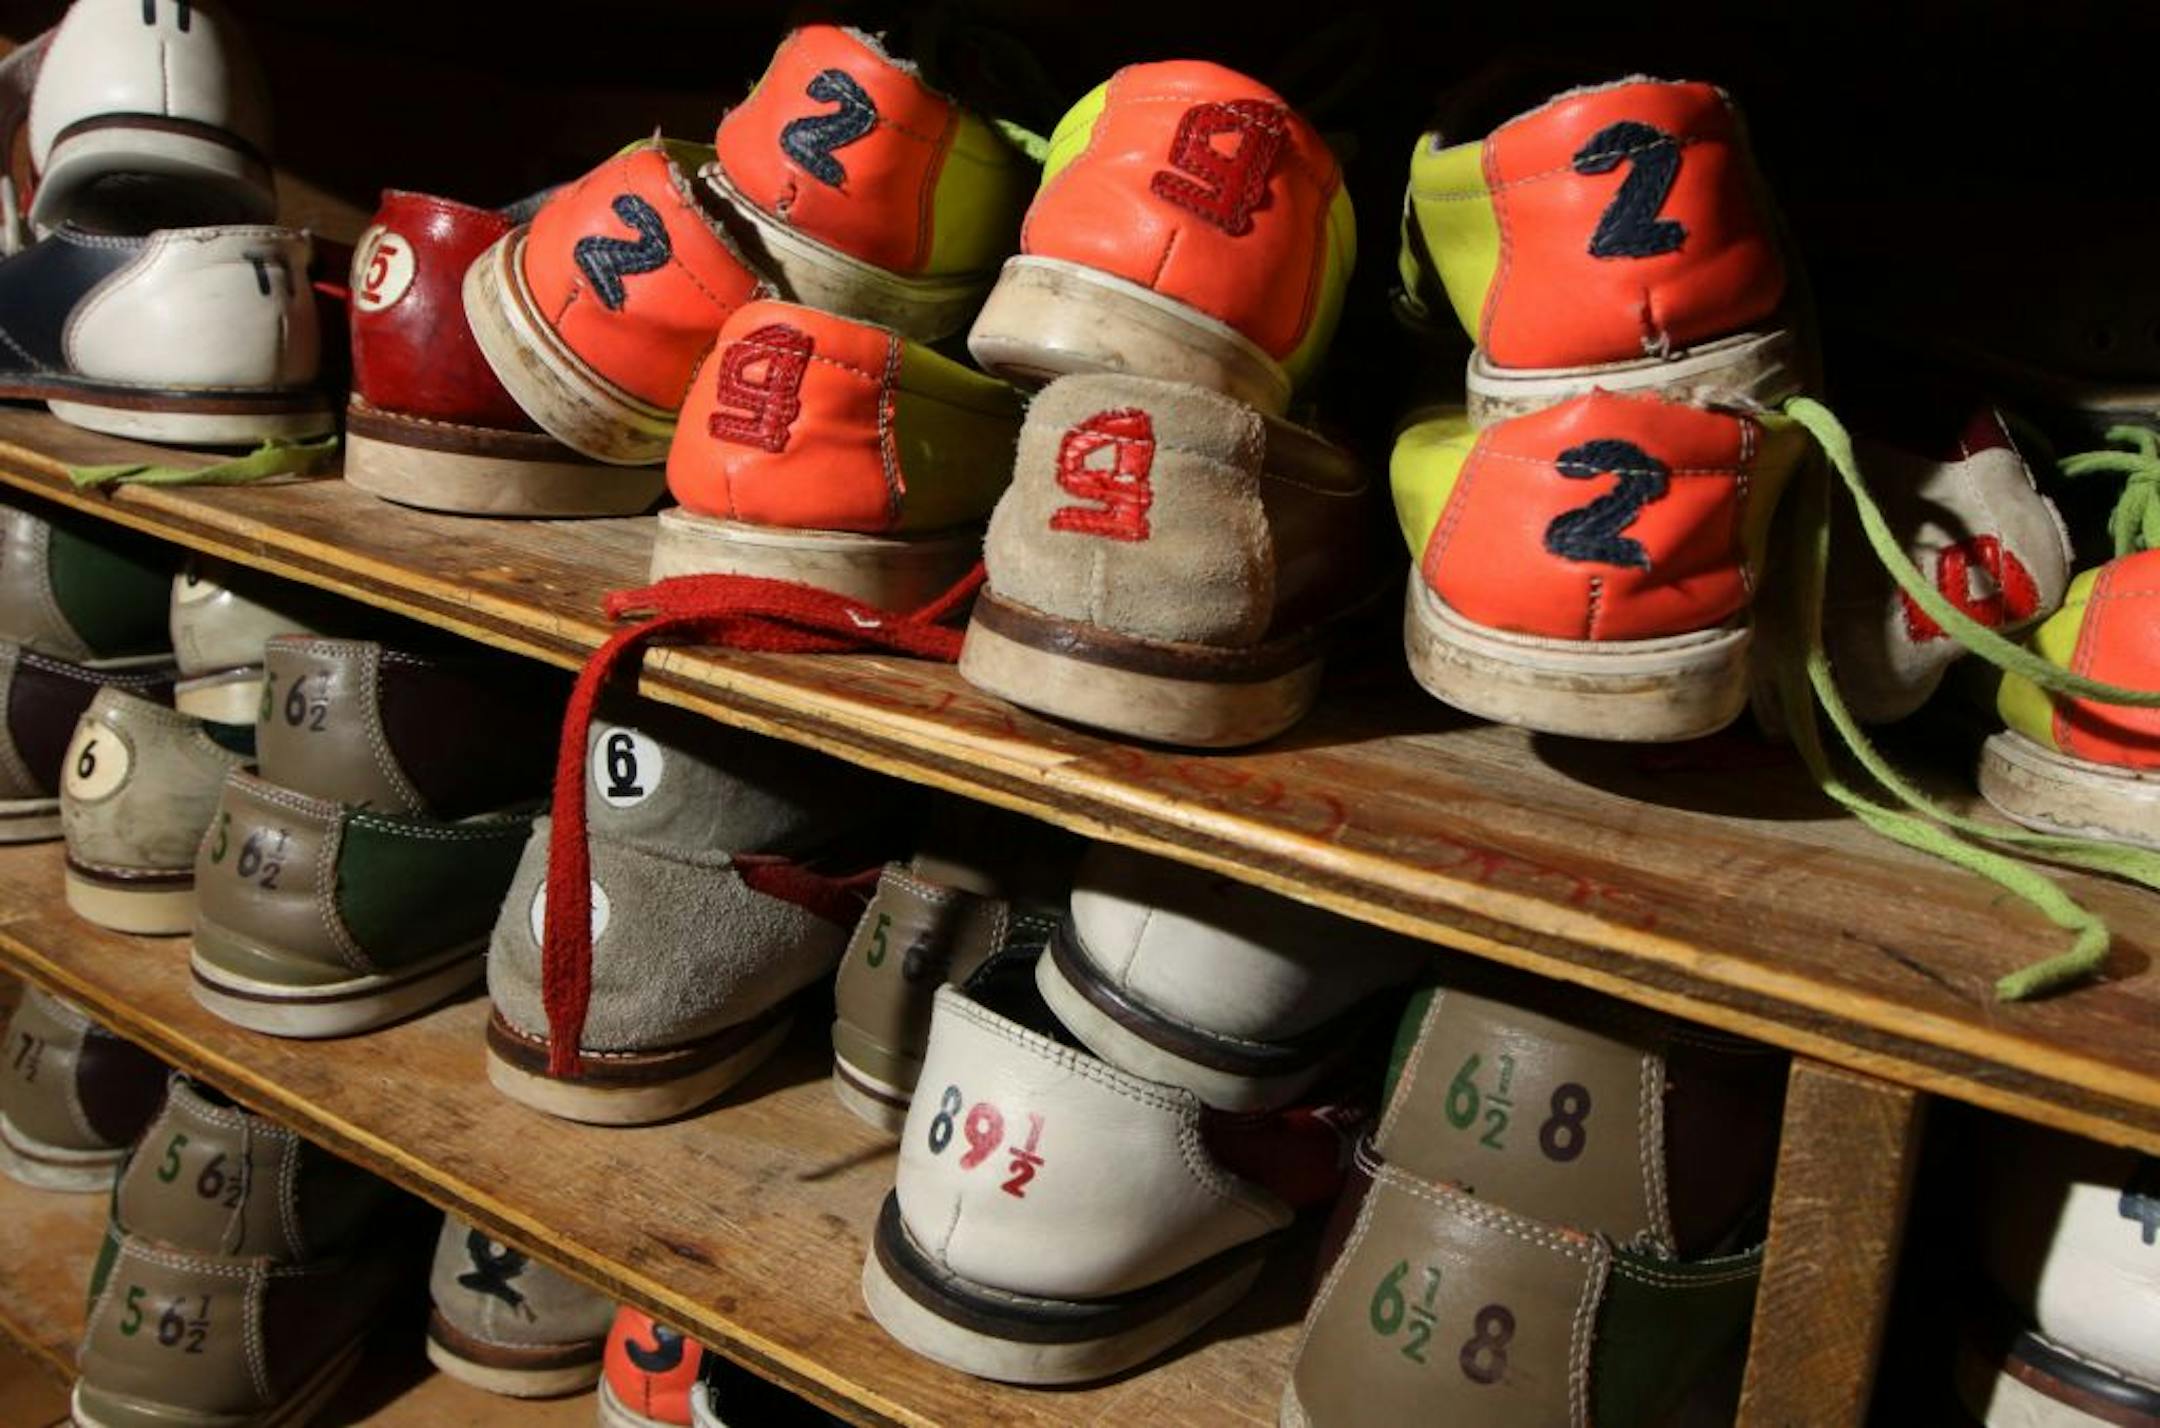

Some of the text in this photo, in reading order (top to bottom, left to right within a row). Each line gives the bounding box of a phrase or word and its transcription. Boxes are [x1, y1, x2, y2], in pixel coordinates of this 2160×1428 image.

[781, 69, 878, 187] 2
[1574, 122, 1687, 257] 2
[361, 244, 398, 304] 5
[575, 194, 671, 310] 2
[1544, 439, 1669, 570] 2
[78, 740, 98, 778] 6
[607, 733, 643, 797] 6
[867, 912, 891, 968] 5
[928, 1085, 962, 1154] 8
[1539, 1082, 1591, 1162] 8
[157, 1135, 188, 1182] 5
[120, 1286, 146, 1336] 5
[1459, 1304, 1515, 1384] 8
